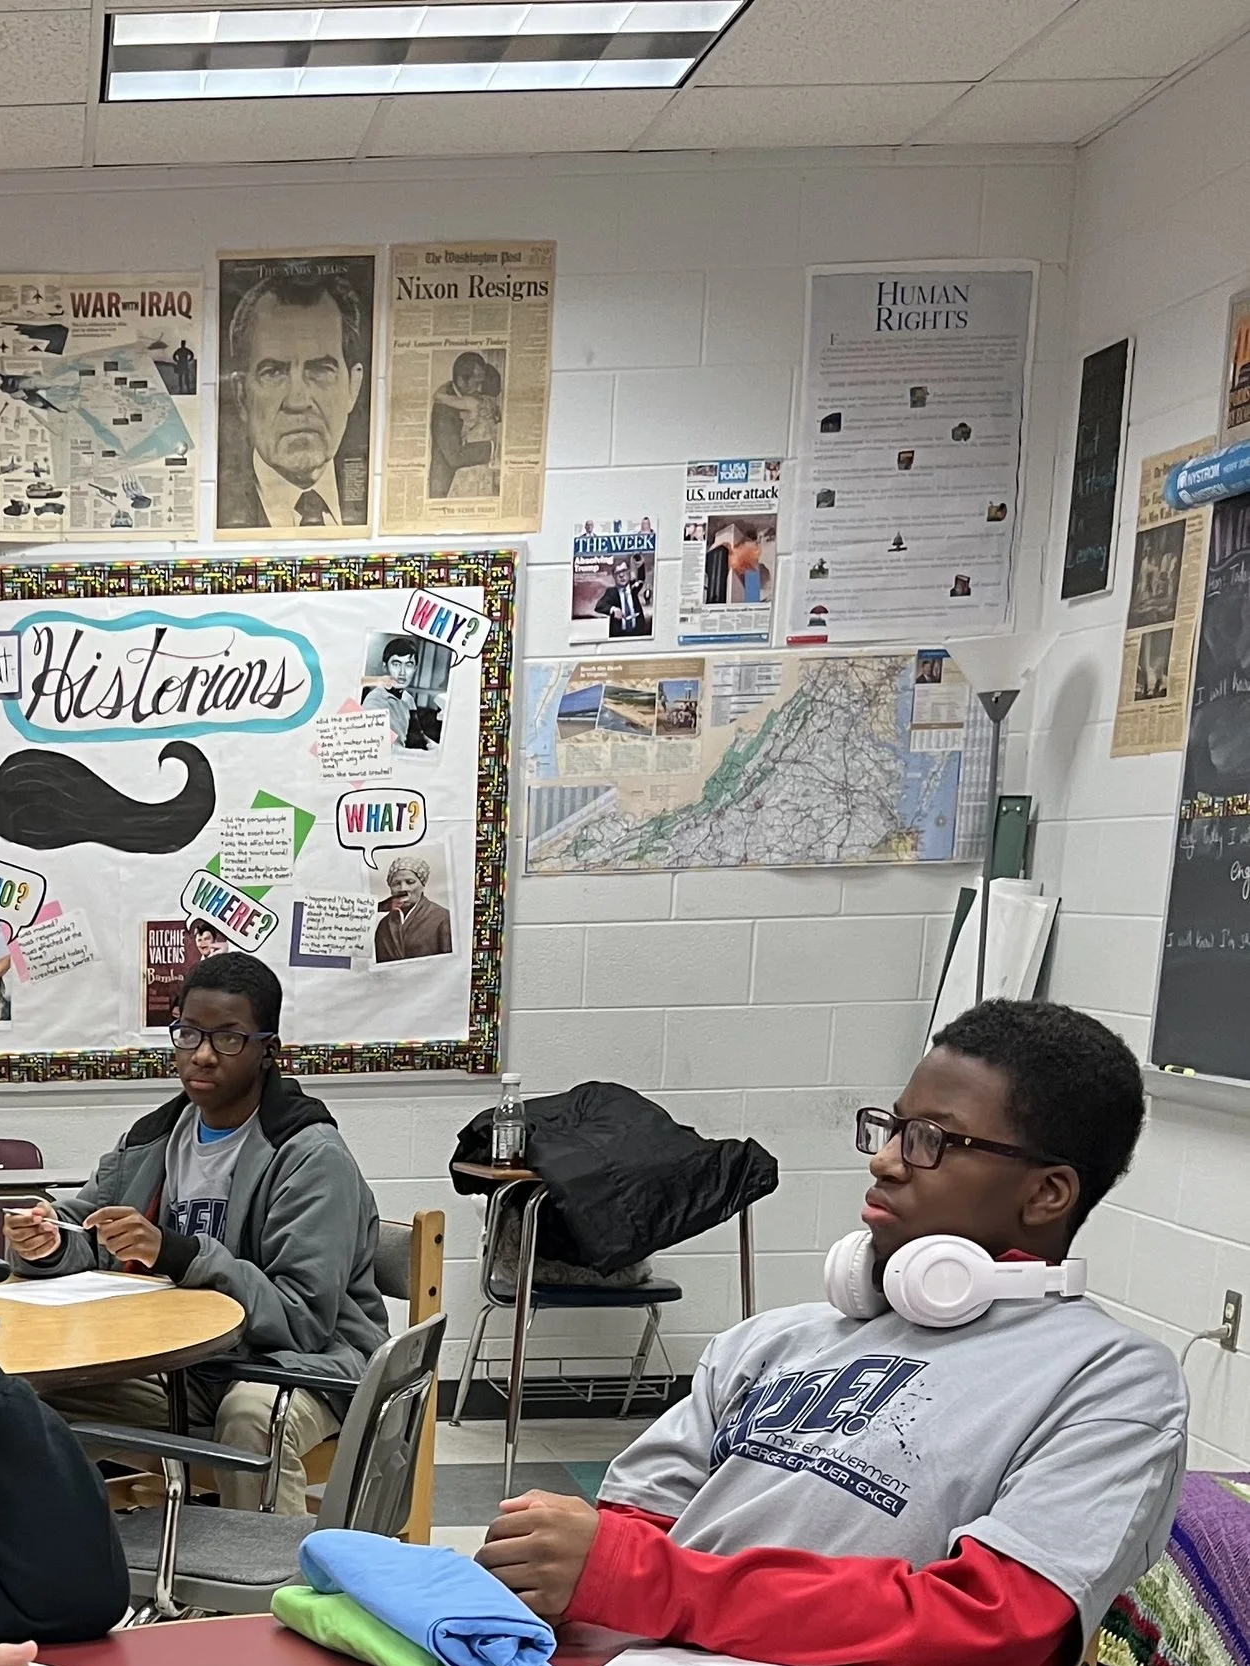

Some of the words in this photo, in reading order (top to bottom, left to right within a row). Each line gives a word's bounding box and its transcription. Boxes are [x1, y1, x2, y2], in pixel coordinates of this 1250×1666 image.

[425, 252, 442, 265] The
[445, 250, 498, 265] Washington
[501, 252, 521, 266] Post
[397, 276, 458, 300] Nixon
[468, 274, 548, 302] Resigns
[877, 281, 971, 307] HUMAN
[70, 292, 121, 318] WAR
[140, 291, 192, 319] IRAQ
[875, 307, 968, 332] RIGHTS
[720, 471, 746, 481] TODAY
[728, 463, 746, 472] USA
[1188, 463, 1220, 486] NYSTROM
[686, 489, 705, 501] U.S.
[708, 488, 742, 501] under
[745, 487, 779, 499] attack
[575, 537, 609, 552] THE
[609, 534, 654, 551] WEEK
[574, 565, 599, 573] Trump
[575, 556, 614, 565] Absolving
[411, 596, 479, 647] WHY?
[25, 626, 305, 724] Historians
[345, 801, 420, 833] WHAT?
[191, 878, 274, 941] WHERE?
[149, 930, 185, 946] RITCHIE
[150, 947, 185, 964] VALENS
[147, 968, 184, 984] Bamba
[856, 1481, 898, 1512] EXCEL
